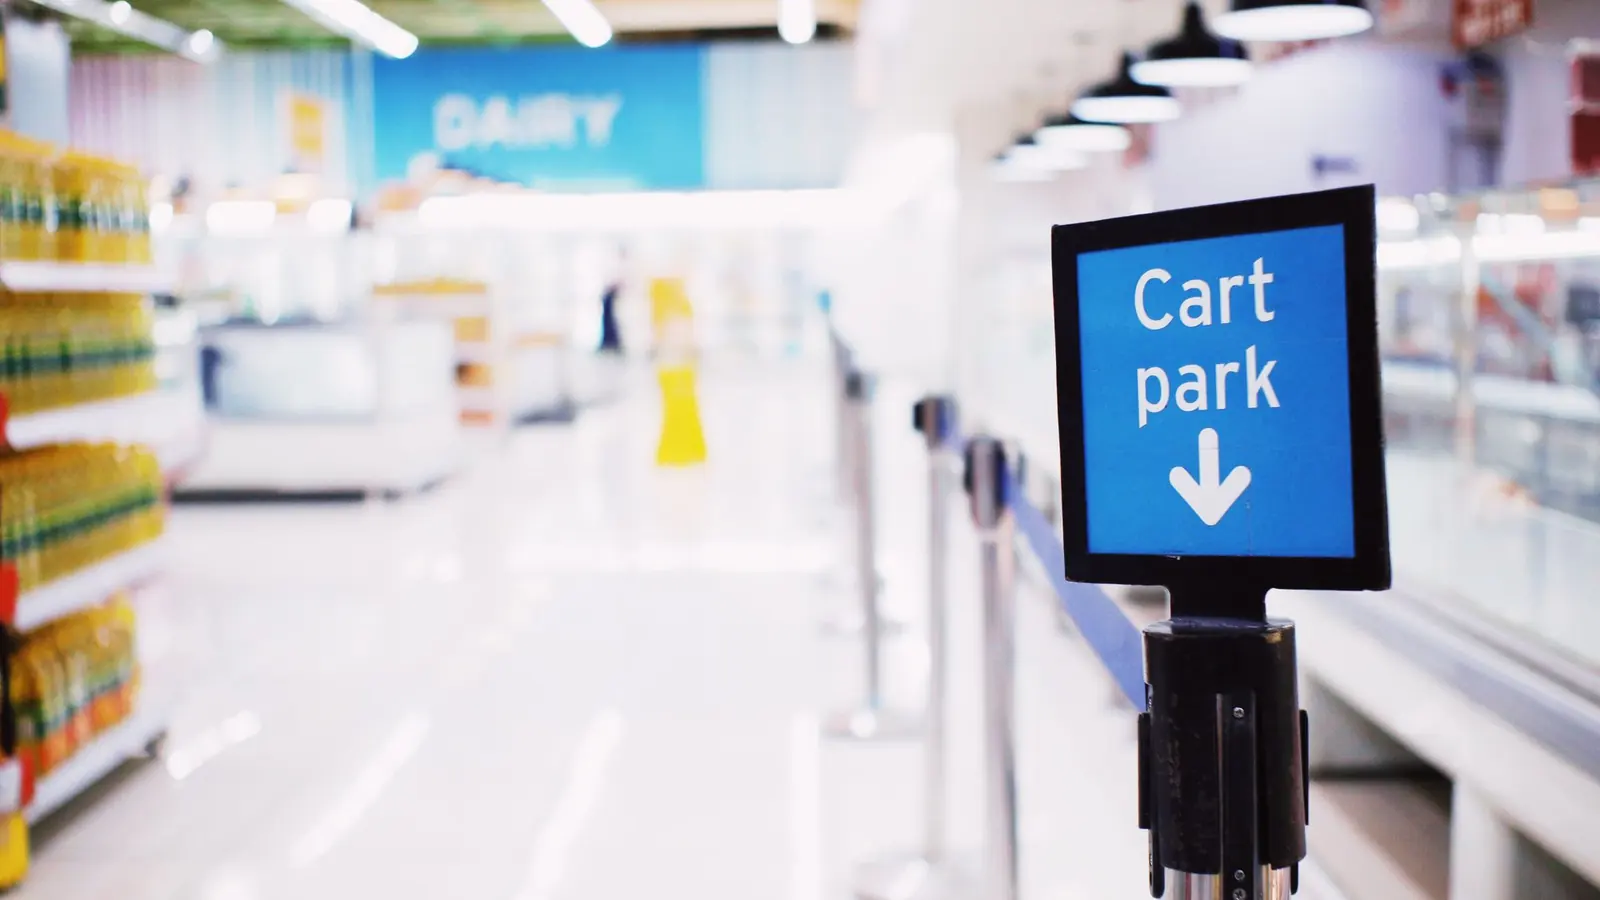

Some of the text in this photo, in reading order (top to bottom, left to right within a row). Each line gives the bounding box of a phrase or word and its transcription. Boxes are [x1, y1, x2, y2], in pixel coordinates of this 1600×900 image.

[434, 93, 621, 149] DAIRY
[1134, 257, 1275, 330] Cart
[1137, 345, 1280, 428] park
